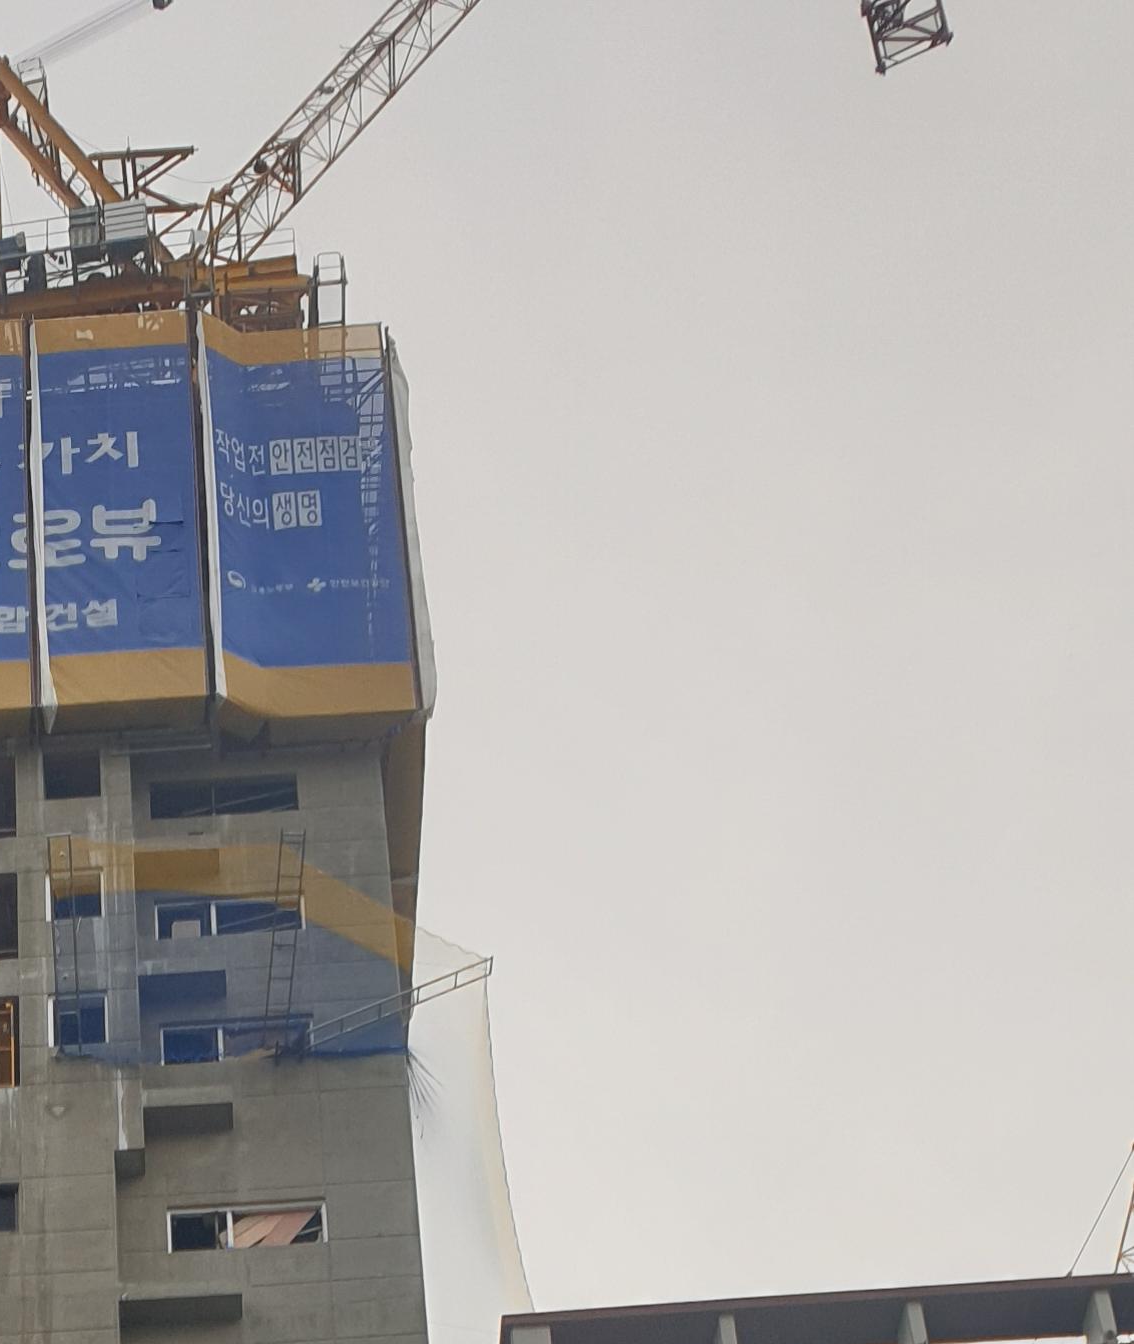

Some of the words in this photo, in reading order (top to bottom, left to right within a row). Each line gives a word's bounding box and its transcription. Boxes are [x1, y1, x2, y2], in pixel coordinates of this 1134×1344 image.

[17, 430, 139, 475] 가치
[219, 481, 270, 530] 당신의
[272, 490, 323, 531] 생명
